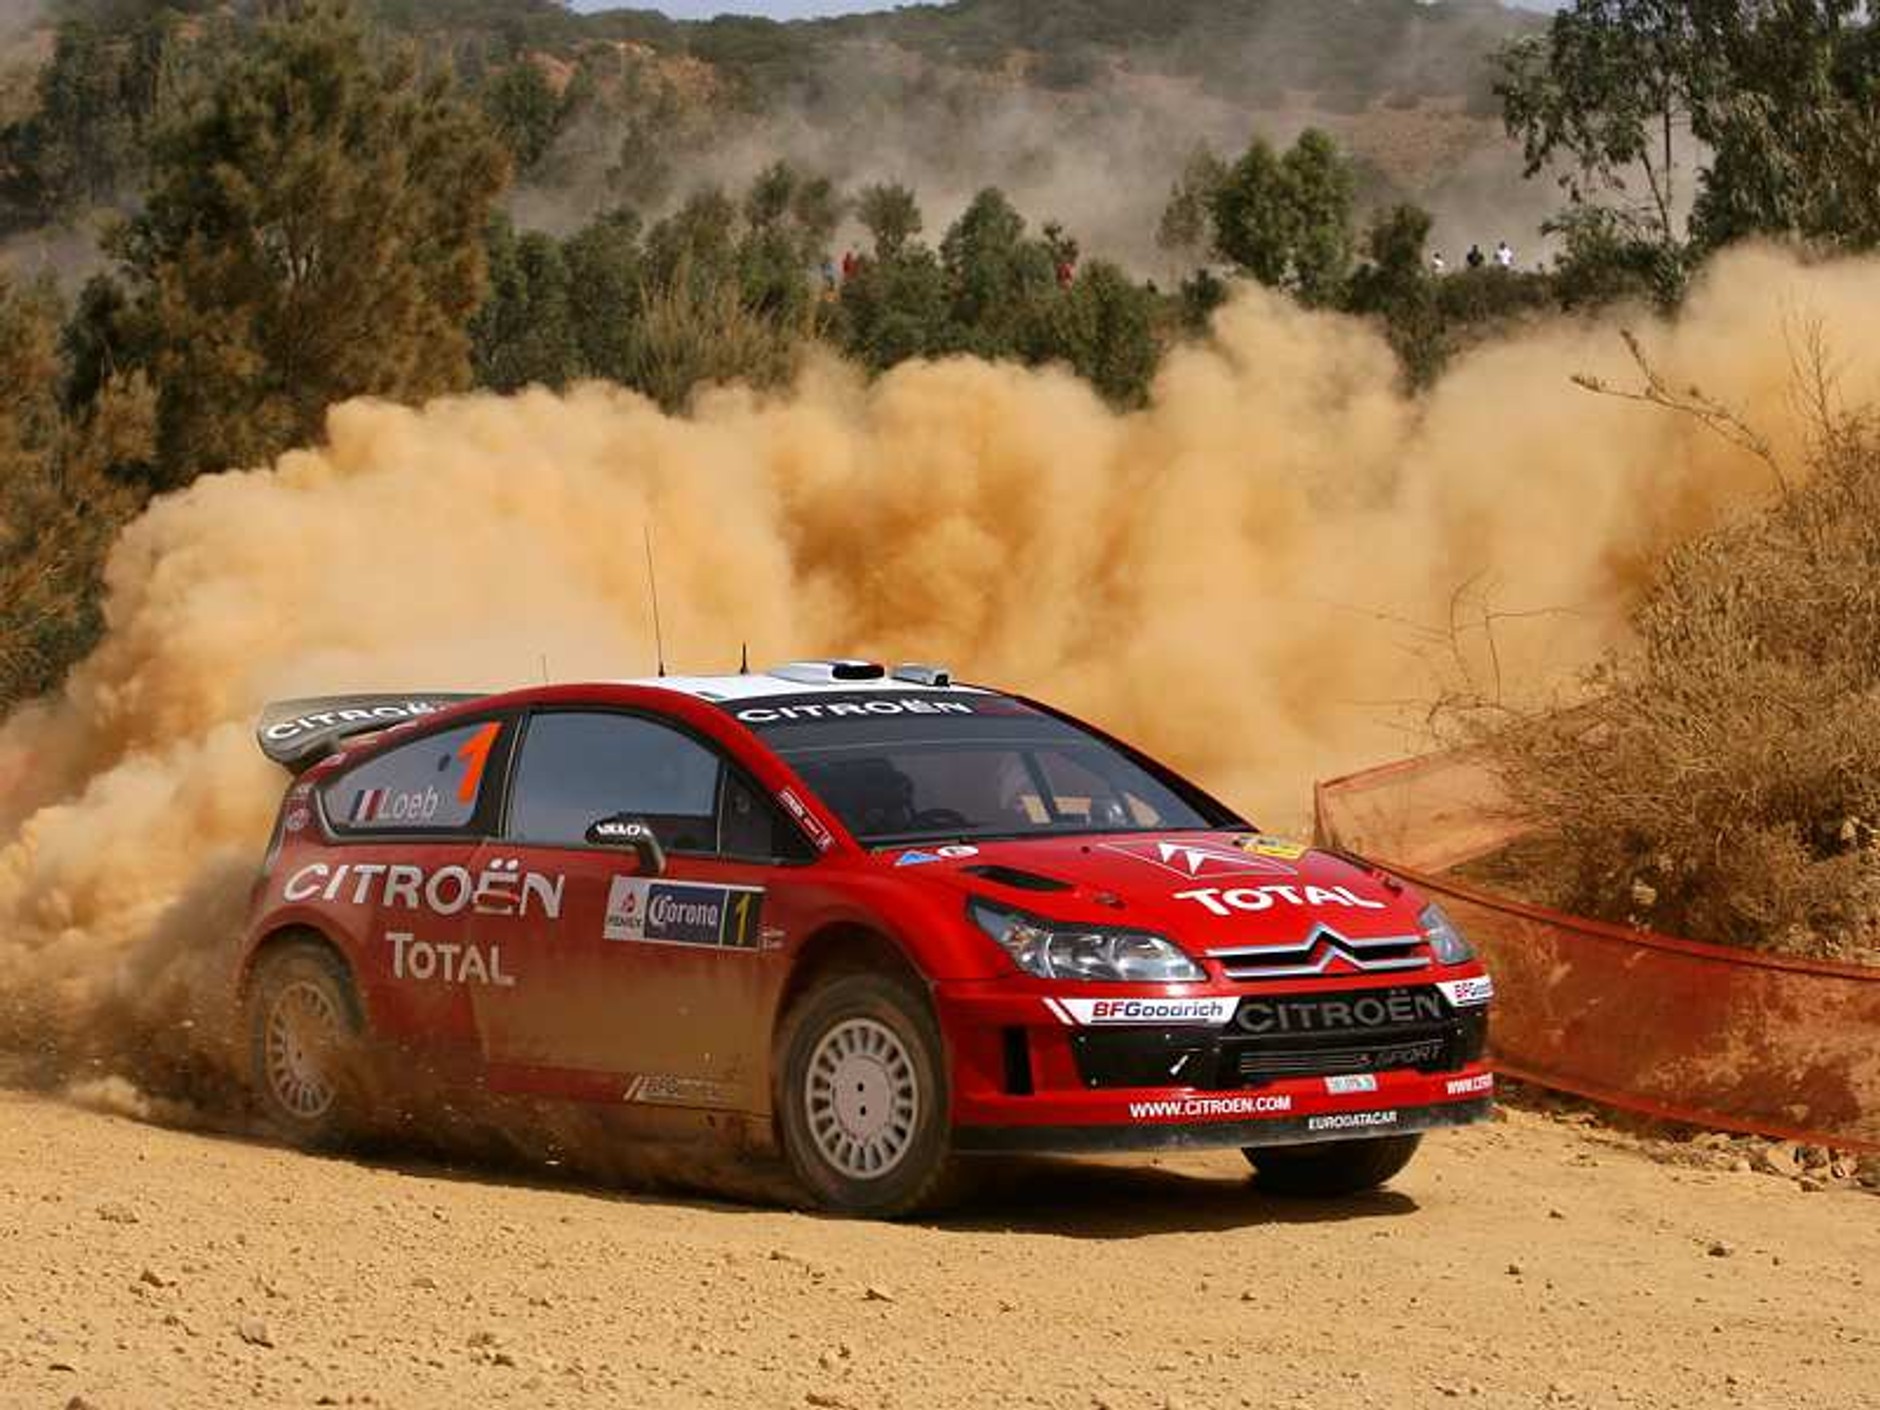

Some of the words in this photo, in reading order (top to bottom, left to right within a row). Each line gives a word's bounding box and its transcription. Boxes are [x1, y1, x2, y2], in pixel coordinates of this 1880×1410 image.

[457, 721, 503, 807] 1
[377, 785, 440, 820] Loeb
[284, 858, 565, 919] CITROËN
[1172, 885, 1388, 916] TOTAL
[649, 895, 719, 926] Corona
[736, 893, 750, 945] 1
[385, 932, 516, 987] TOTAL
[1092, 1001, 1224, 1018] BFGoodrich
[1236, 989, 1441, 1032] CITROËN
[1129, 1096, 1292, 1118] WWW.CITROEN.COM
[1308, 1111, 1398, 1129] EURODATACAR
